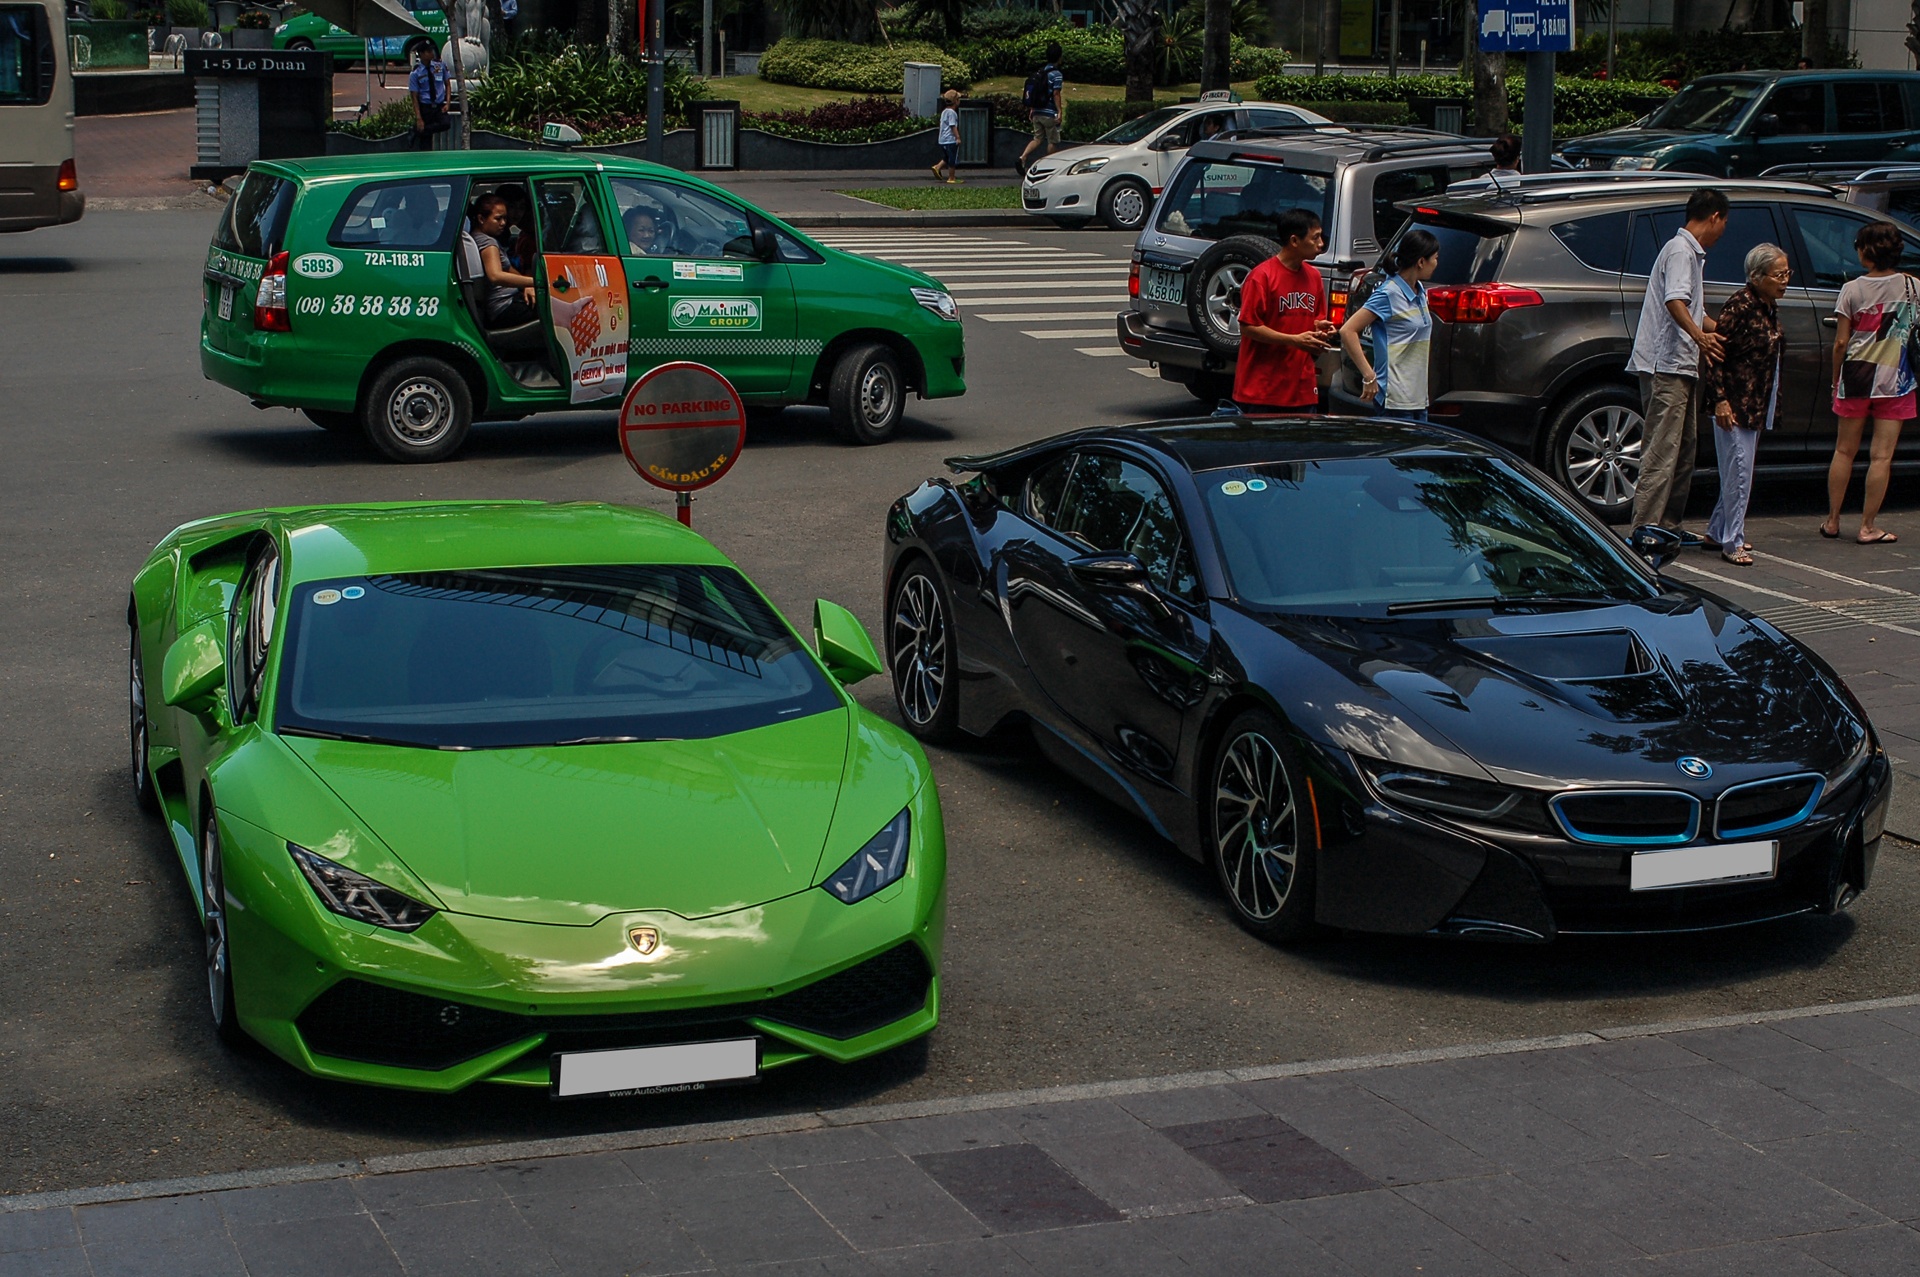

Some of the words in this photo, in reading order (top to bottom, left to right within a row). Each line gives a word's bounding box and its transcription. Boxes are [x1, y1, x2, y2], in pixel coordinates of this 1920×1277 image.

[1542, 19, 1547, 36] 3
[1548, 14, 1566, 36] BÁNH
[236, 58, 257, 70] Le
[261, 58, 306, 71] Duan
[301, 259, 334, 273] 5893
[364, 252, 425, 267] 72A-118.31
[1157, 271, 1176, 287] 51A
[1149, 285, 1181, 303] 458.00
[1279, 291, 1316, 313] NIKE
[295, 296, 326, 316] (08)
[330, 294, 356, 315] 38
[359, 295, 384, 316] 38
[387, 296, 412, 316] 38
[415, 297, 440, 317] 38
[709, 318, 749, 326] GROUP
[634, 404, 657, 416] NO
[661, 399, 731, 415] PARKING
[710, 453, 728, 471] XE
[608, 1081, 706, 1098] www.AutoSeredin.de
